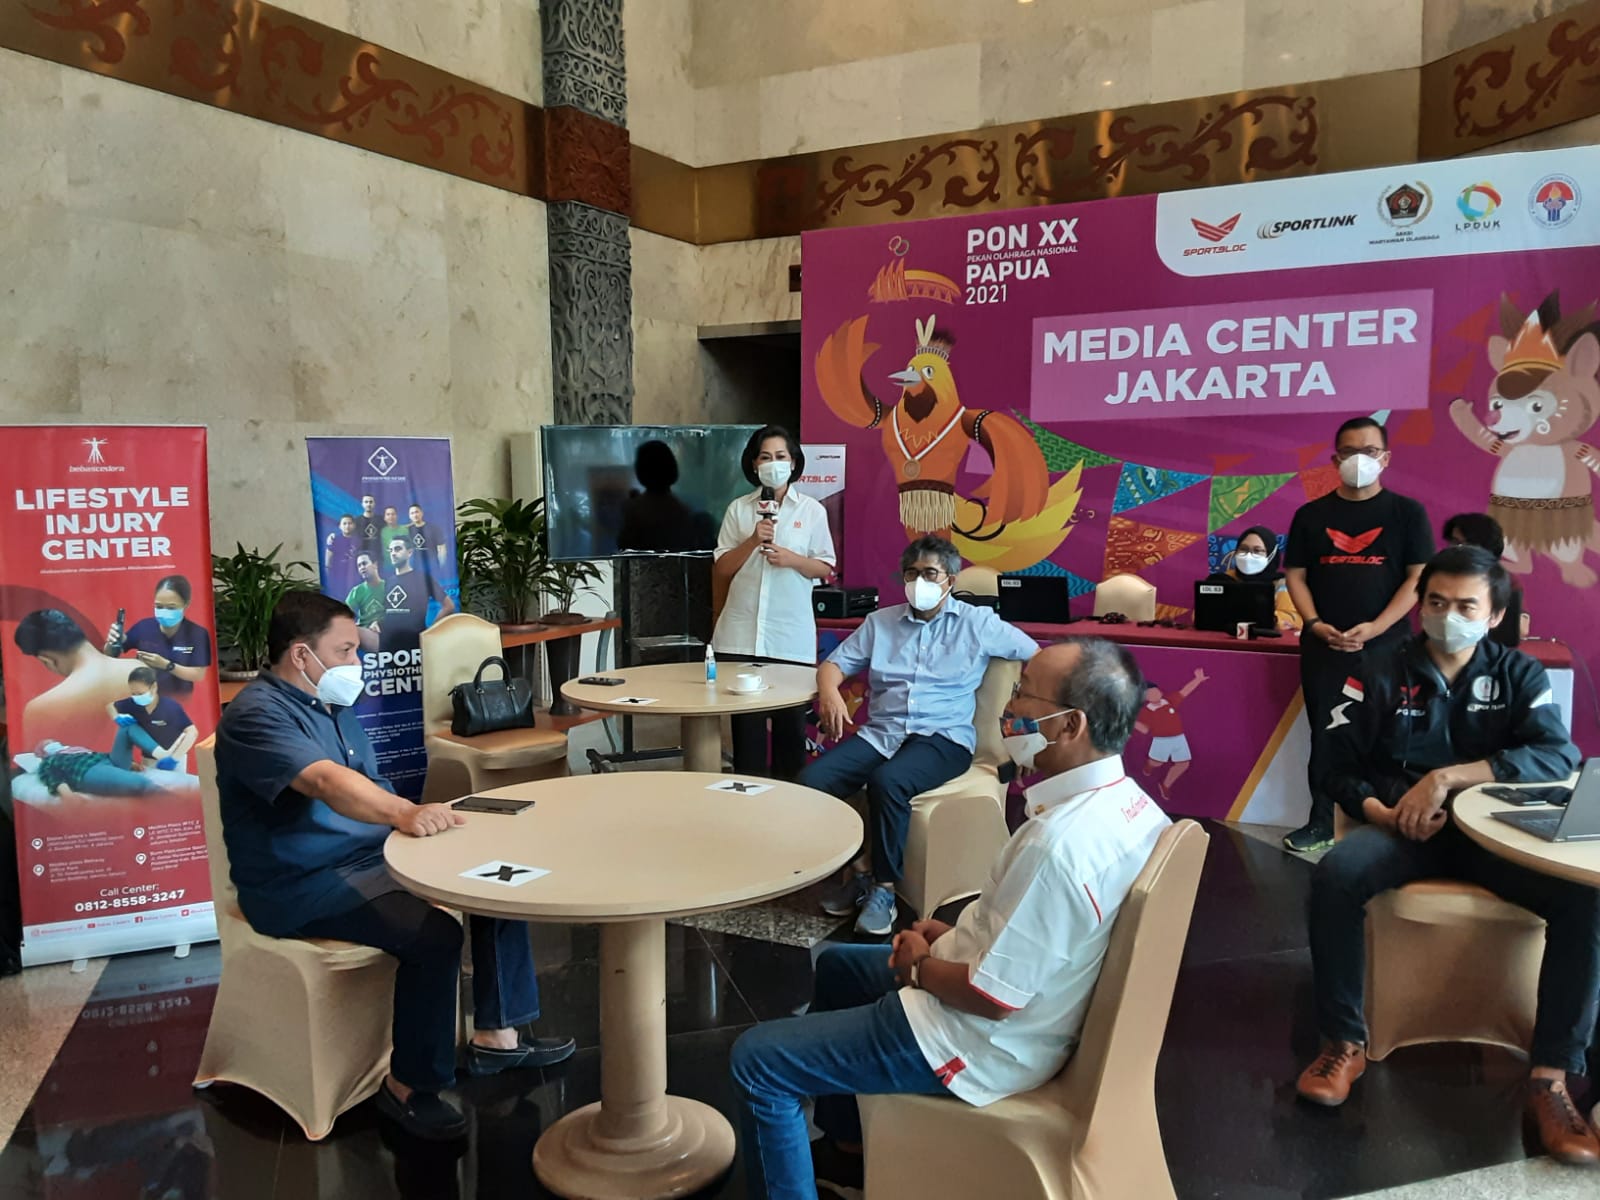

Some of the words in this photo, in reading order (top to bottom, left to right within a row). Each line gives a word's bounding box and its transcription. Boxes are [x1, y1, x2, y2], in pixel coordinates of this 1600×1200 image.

[1272, 214, 1358, 233] SPORTLINK
[967, 223, 1028, 254] PON
[1038, 217, 1079, 247] XX
[967, 254, 993, 263] PEKAN
[993, 249, 1036, 261] OLAHRAGA
[1037, 245, 1078, 256] NASIONAL
[966, 257, 1050, 285] PAPUA
[965, 284, 1007, 305] 2021
[1043, 323, 1191, 364] MEDIA
[1206, 308, 1418, 353] CENTER
[1104, 361, 1336, 405] JAKARTA
[15, 486, 189, 510] LIFESTYLE
[45, 512, 164, 535] INJURY
[41, 537, 172, 561] CENTER
[363, 649, 422, 670] SPOR
[364, 676, 422, 697] CENT
[75, 889, 185, 912] 0812-8558-3247
[100, 887, 119, 897] Call
[121, 883, 159, 896] Center:
